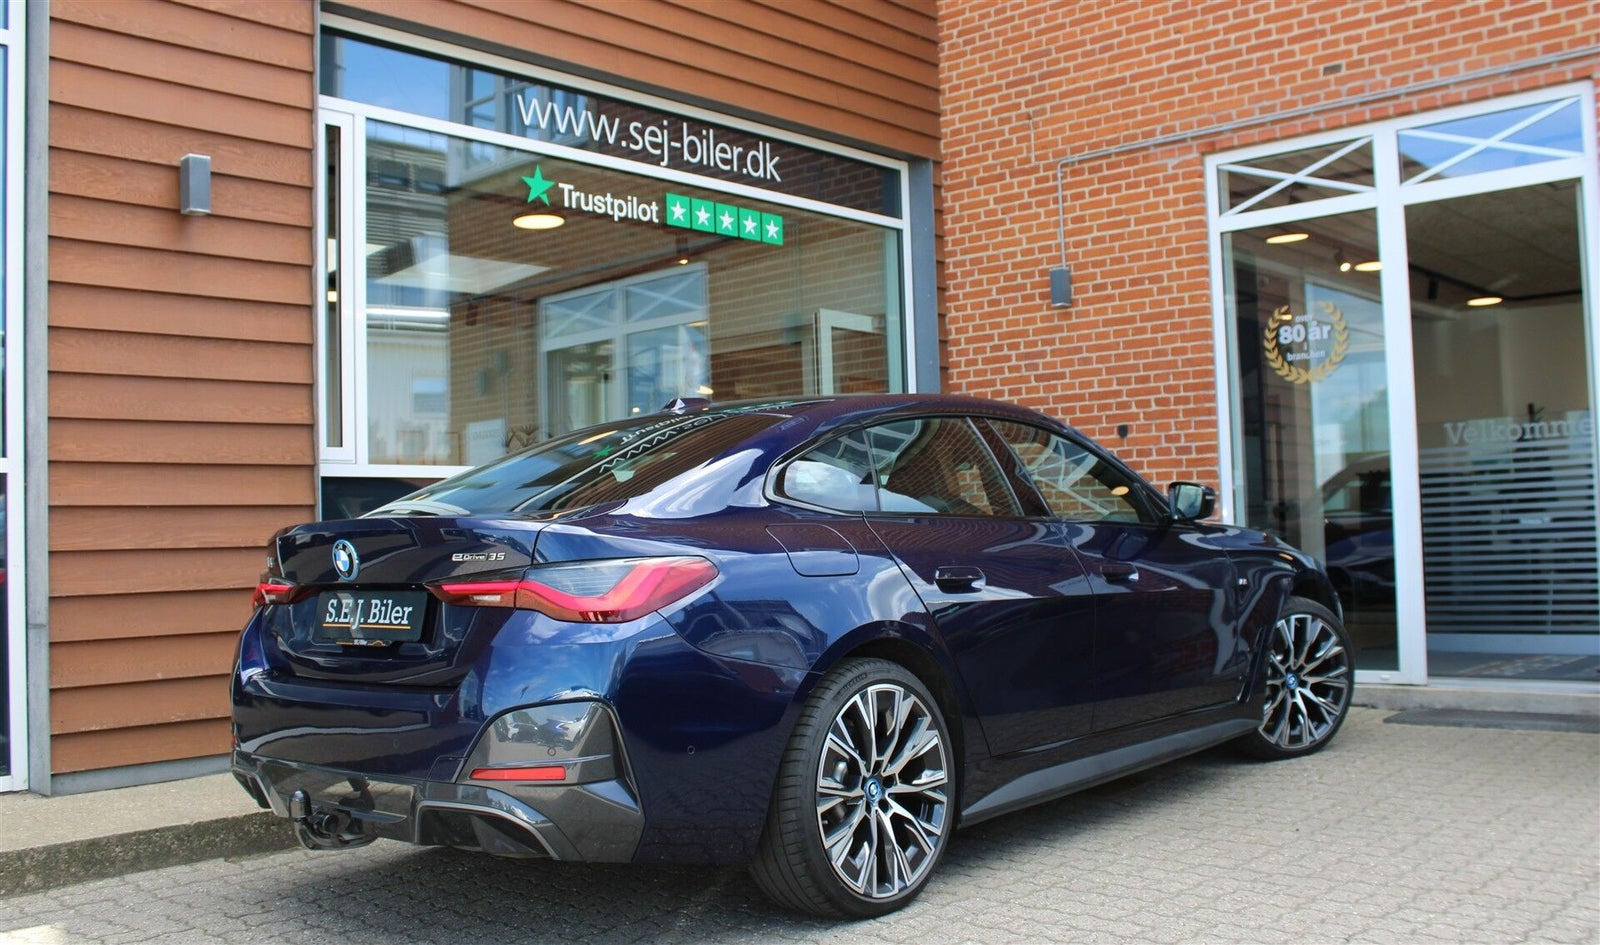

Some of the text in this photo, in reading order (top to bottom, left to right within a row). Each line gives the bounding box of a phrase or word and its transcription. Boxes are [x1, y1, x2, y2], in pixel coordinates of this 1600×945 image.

[517, 94, 782, 183] www.sej-biler.dk
[558, 182, 660, 224] Trustpilot
[1279, 320, 1331, 344] 80 år
[367, 599, 413, 625] Biler
